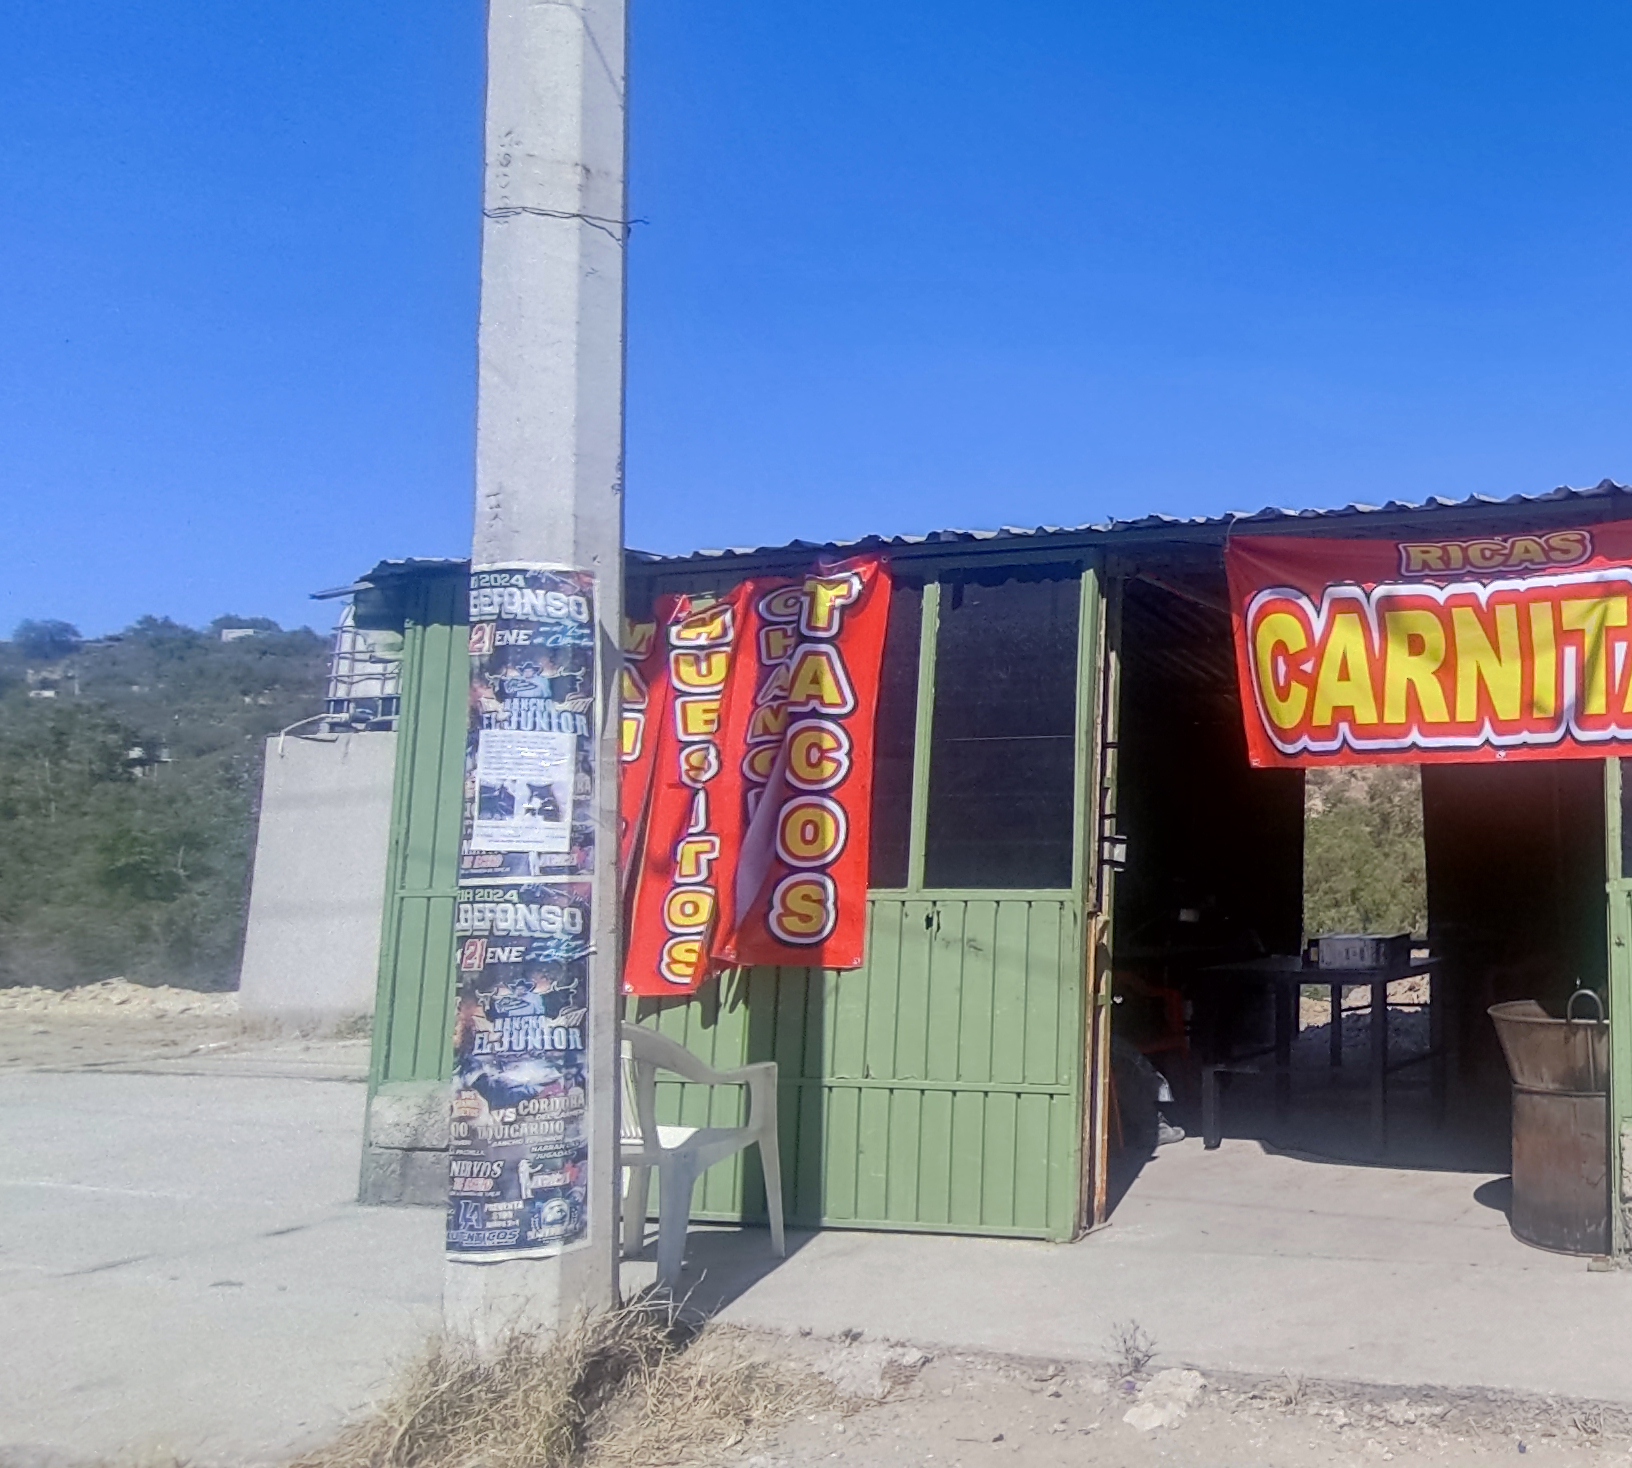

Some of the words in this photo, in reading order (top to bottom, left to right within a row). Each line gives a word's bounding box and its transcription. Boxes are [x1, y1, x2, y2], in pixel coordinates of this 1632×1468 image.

[1404, 532, 1591, 574] RICAS
[480, 574, 526, 589] 2024
[495, 630, 534, 646] ENE
[769, 572, 862, 947] TACOS
[660, 606, 733, 985] HUESITOS
[475, 888, 519, 902] 2024
[456, 903, 583, 937] DEFONSO
[461, 938, 488, 971] 21
[485, 946, 527, 963] ENE
[494, 1025, 584, 1051] JUNIOR
[491, 1107, 517, 1122] VS
